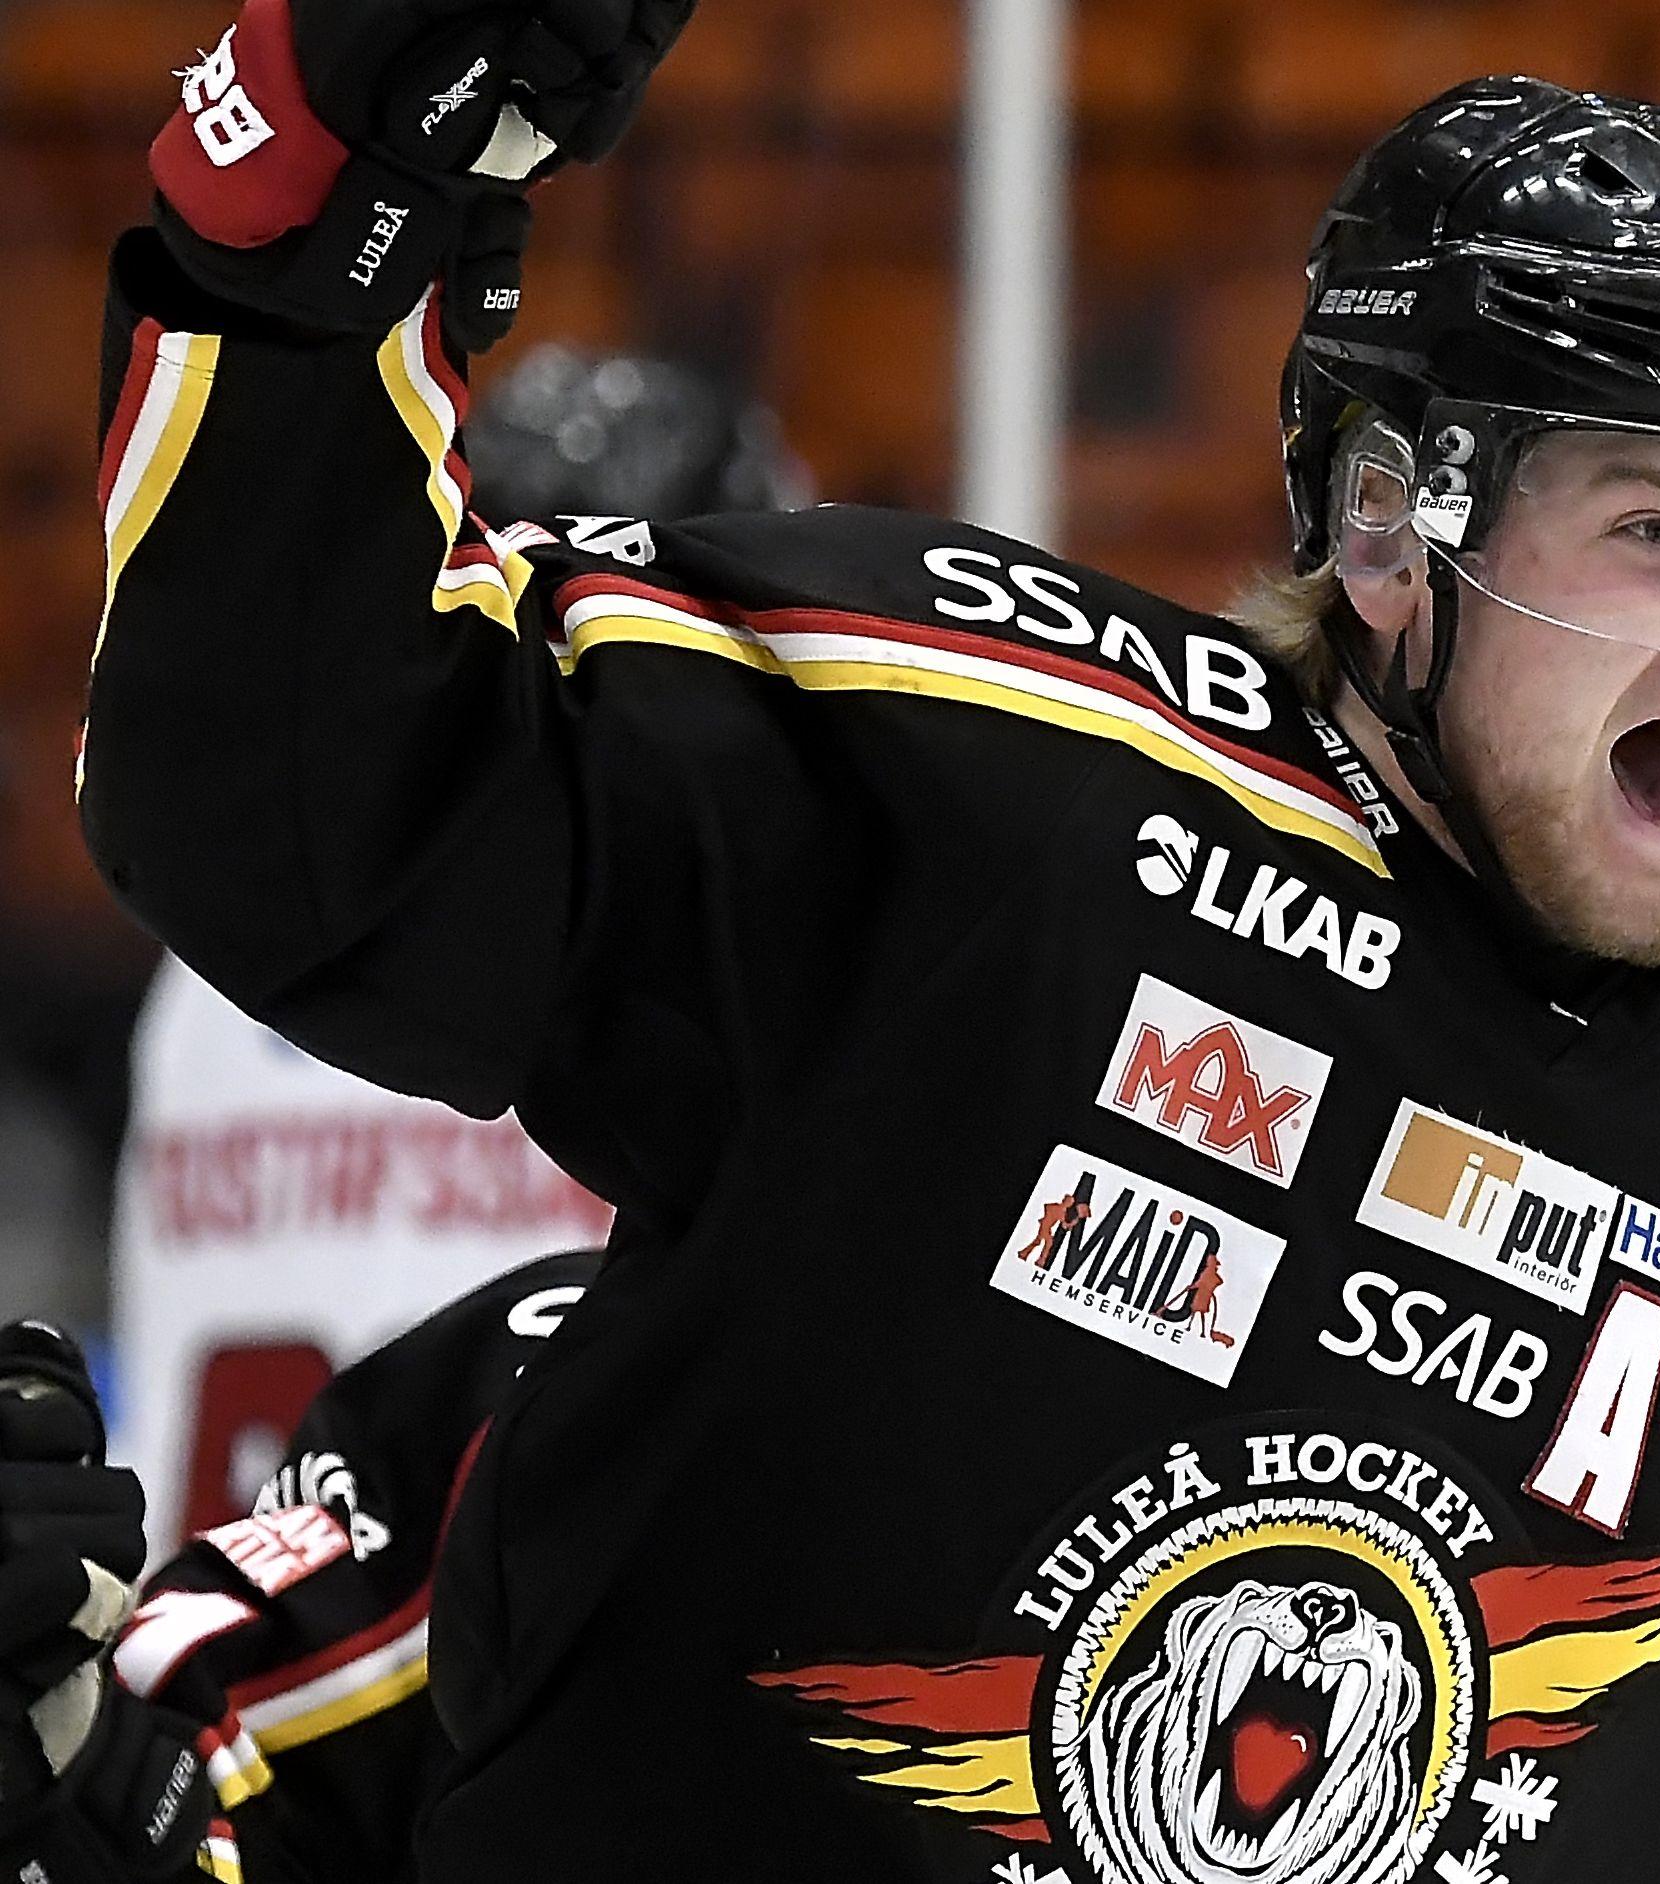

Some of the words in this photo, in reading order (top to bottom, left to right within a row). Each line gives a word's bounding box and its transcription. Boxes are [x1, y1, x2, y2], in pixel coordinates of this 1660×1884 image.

[348, 201, 409, 287] LULEÅ
[1317, 289, 1417, 315] BAUER
[1419, 497, 1468, 512] BAUER
[923, 547, 1272, 731] SSAB
[1190, 845, 1401, 989] LKAB
[1113, 1021, 1313, 1178] MAX
[1443, 1152, 1598, 1278] input
[1513, 1256, 1578, 1295] interiör
[1030, 1269, 1184, 1345] HEMSERVICE
[1318, 1271, 1549, 1419] SSAB
[1014, 1442, 1221, 1632] LULEÅ
[1244, 1433, 1494, 1557] HOCKEY
